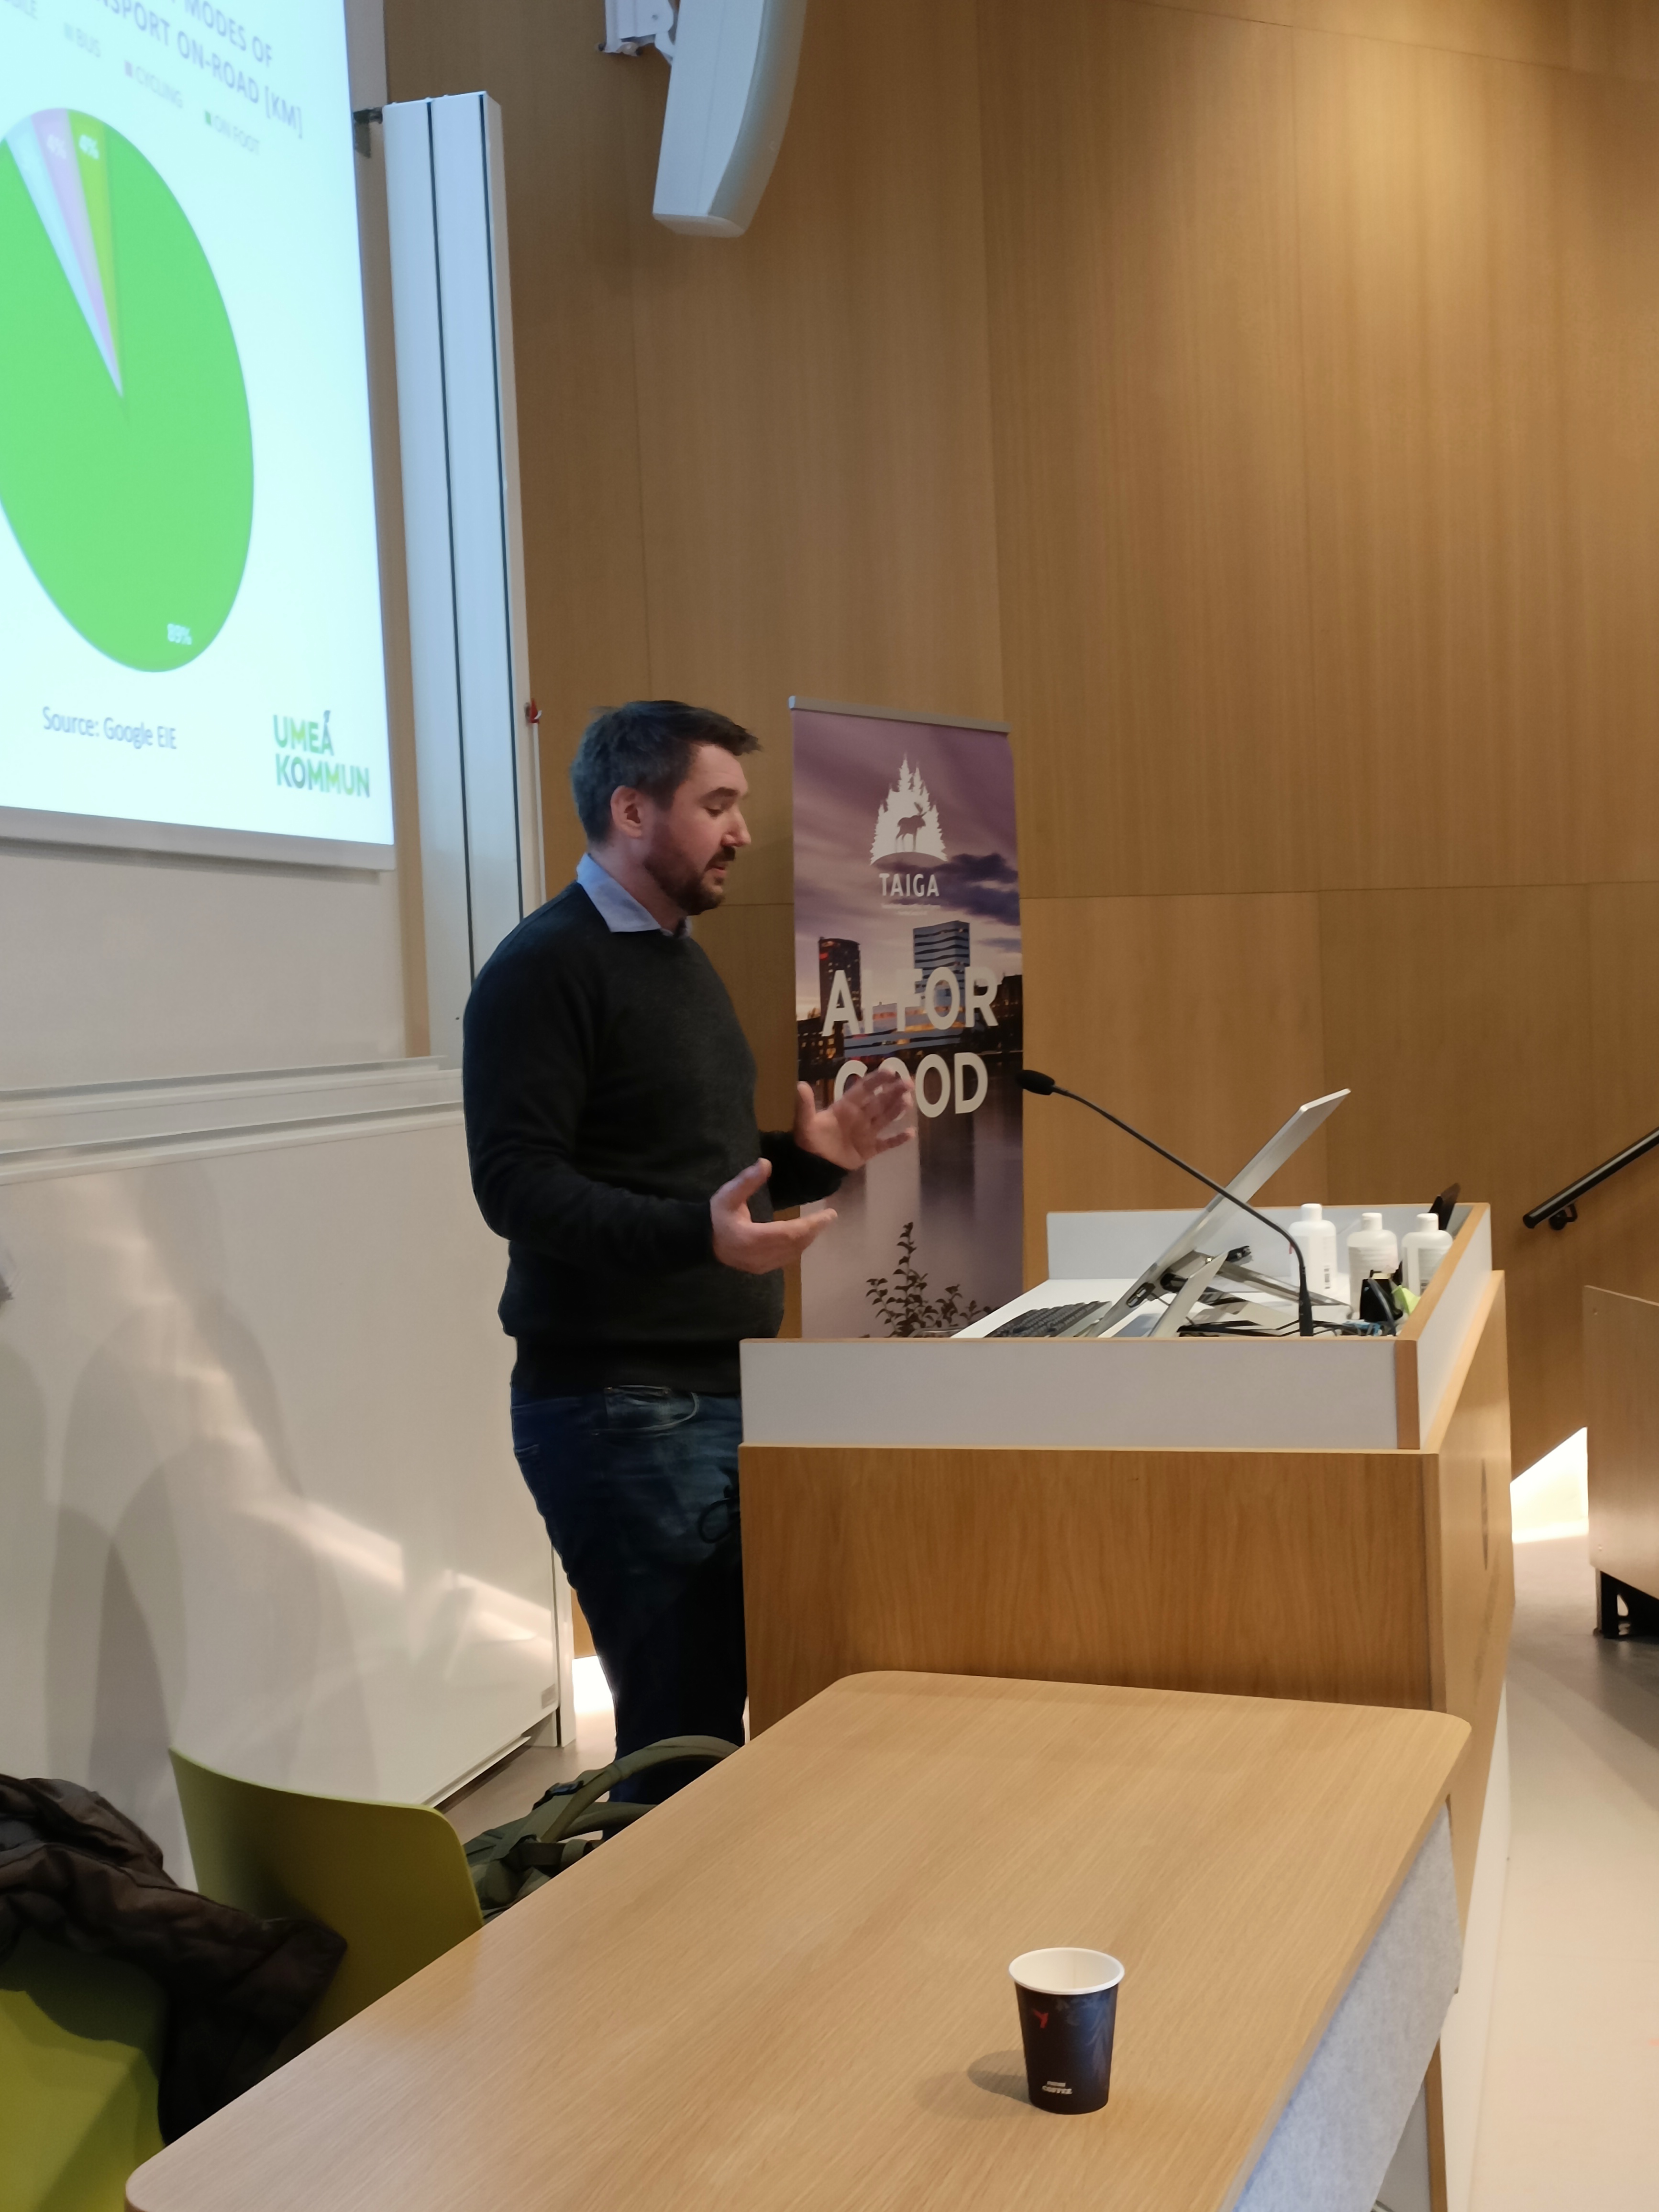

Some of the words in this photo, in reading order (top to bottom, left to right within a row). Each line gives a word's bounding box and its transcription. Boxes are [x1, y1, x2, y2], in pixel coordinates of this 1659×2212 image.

[76, 28, 101, 58] BUS
[185, 0, 246, 51] MODES
[252, 36, 272, 67] OF
[103, 0, 170, 46] SPORT
[177, 31, 259, 103] ON-ROAD
[265, 86, 303, 139] [KM]
[135, 66, 184, 109] CYCLING
[43, 706, 100, 737] Source:
[103, 717, 153, 750] Google
[157, 726, 177, 750] EIE
[276, 753, 370, 798] KOMMUN
[879, 873, 940, 897] TAIGA
[822, 970, 874, 1037] AI
[896, 966, 998, 1032] FOR
